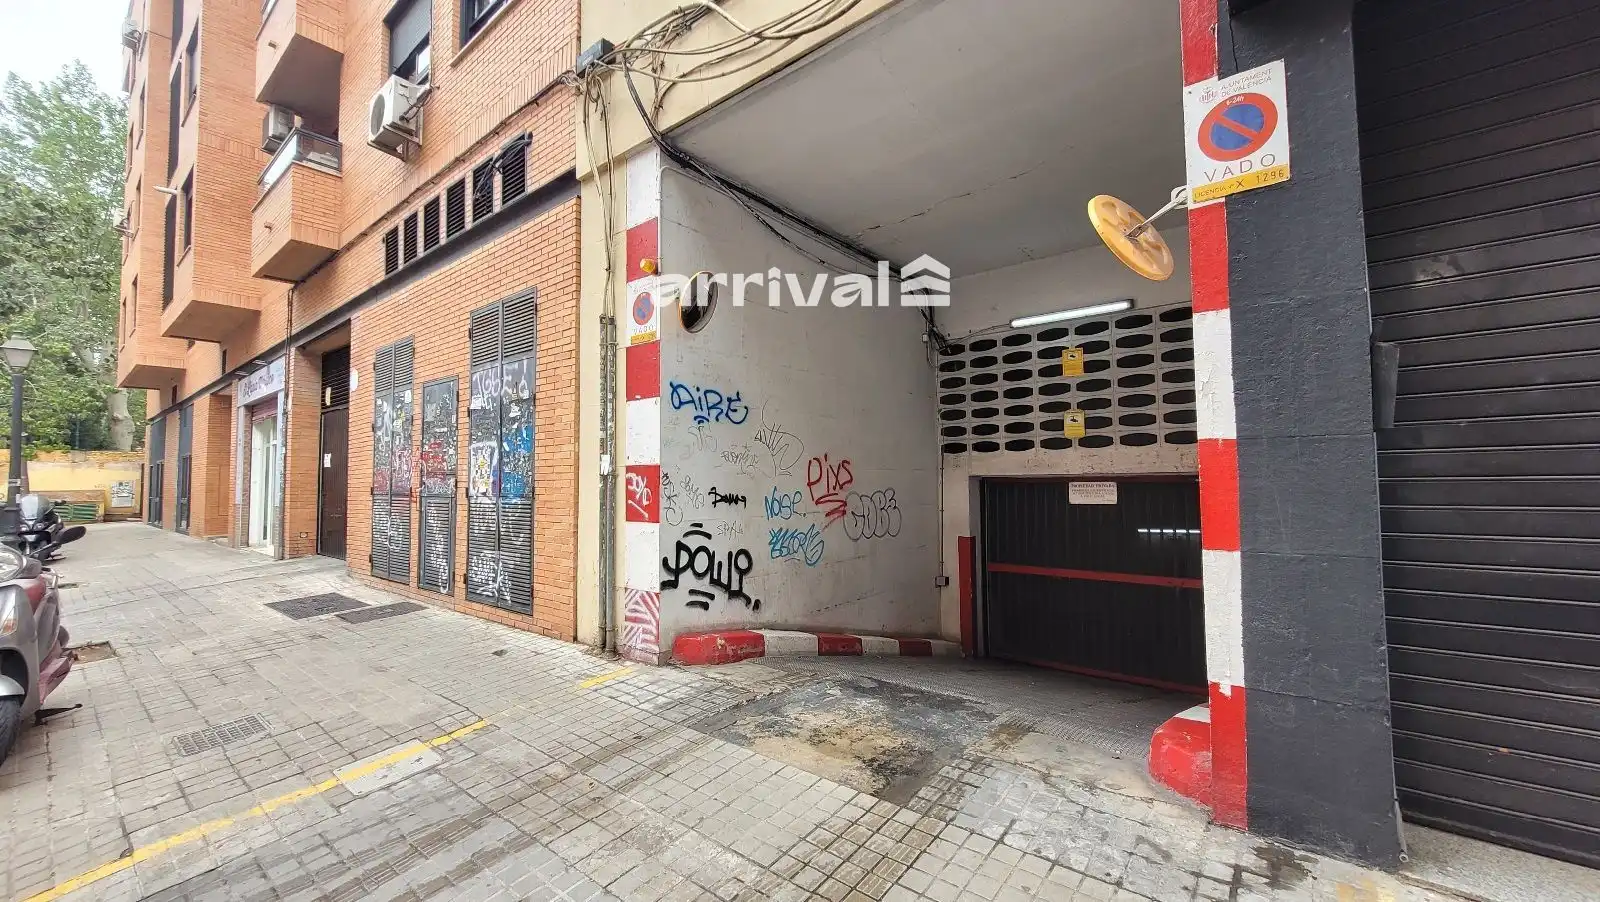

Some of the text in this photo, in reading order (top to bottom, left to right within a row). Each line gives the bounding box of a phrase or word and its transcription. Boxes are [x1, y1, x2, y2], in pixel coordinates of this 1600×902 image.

[1204, 153, 1276, 183] VADO
[1194, 184, 1227, 199] LICENCIA
[1236, 179, 1245, 190] X
[1256, 169, 1284, 184] 1296
